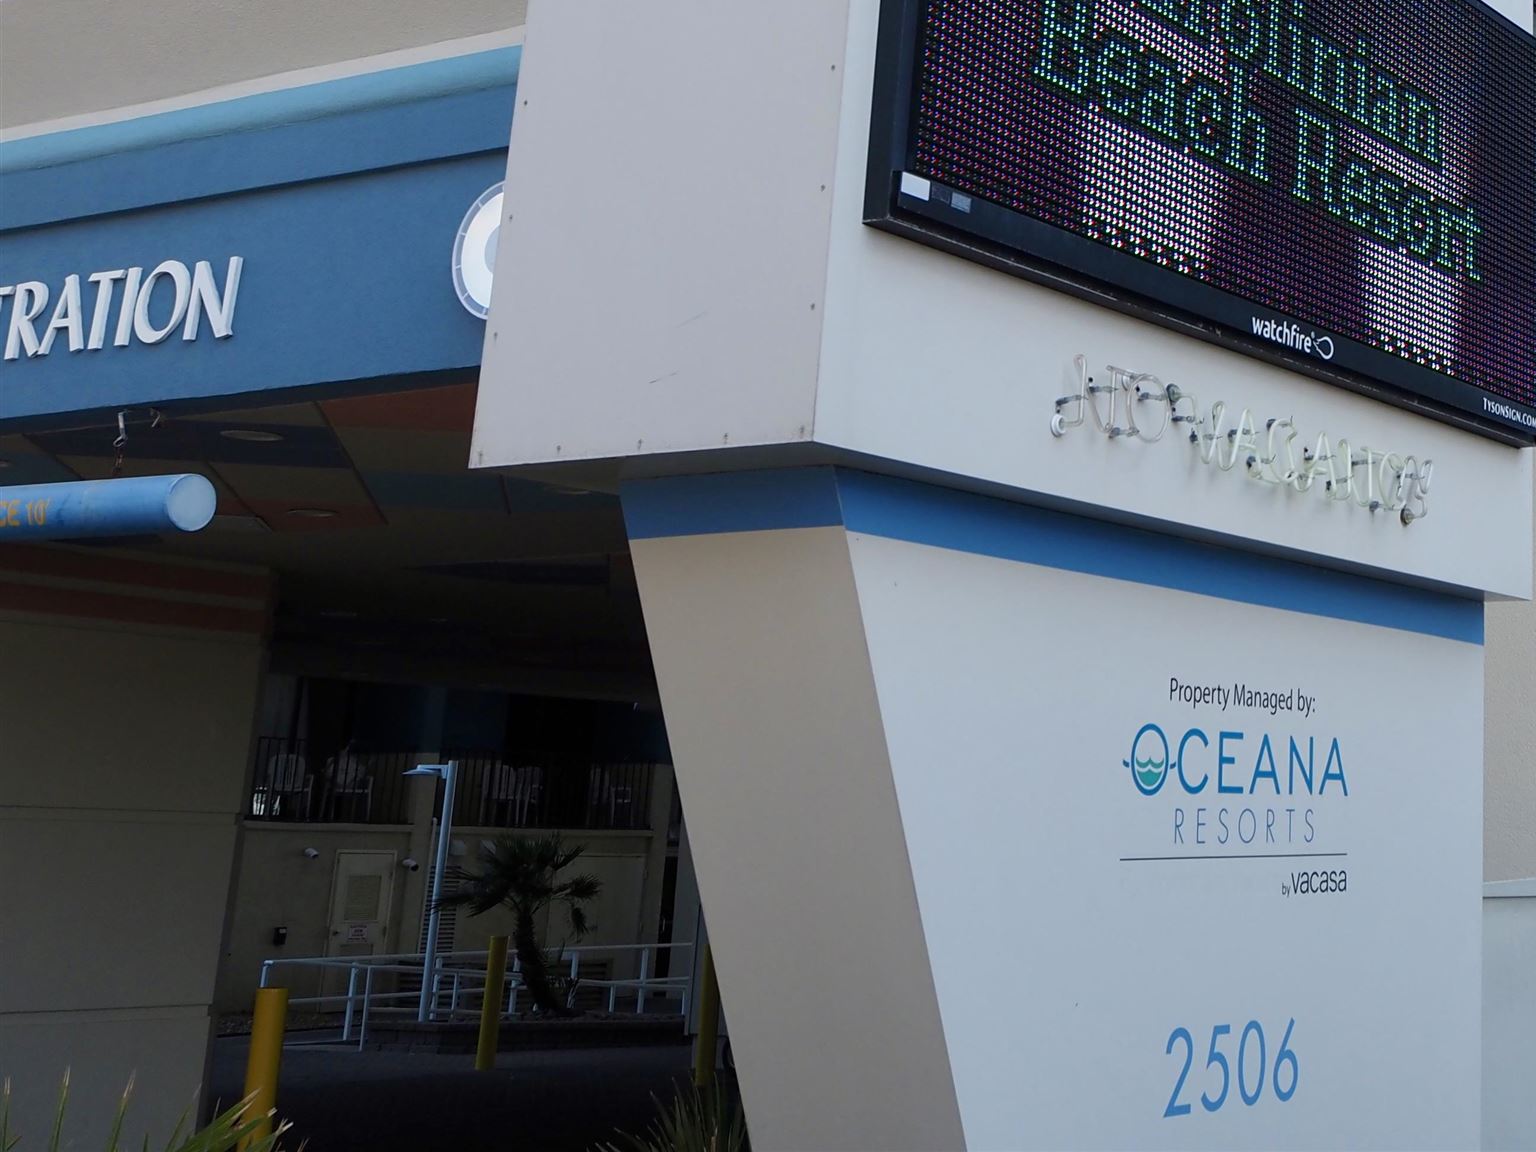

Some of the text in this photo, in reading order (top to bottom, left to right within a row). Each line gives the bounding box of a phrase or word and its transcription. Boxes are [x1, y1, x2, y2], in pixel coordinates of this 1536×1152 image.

[1290, 106, 1483, 282] Resort
[1251, 316, 1312, 354] watchfire
[1169, 677, 1316, 718] Property Managed by:
[1122, 723, 1348, 796] OCEANA
[1174, 807, 1315, 845] RESORTS
[1281, 870, 1347, 898] by vacasa
[1163, 1017, 1299, 1118] 2506
